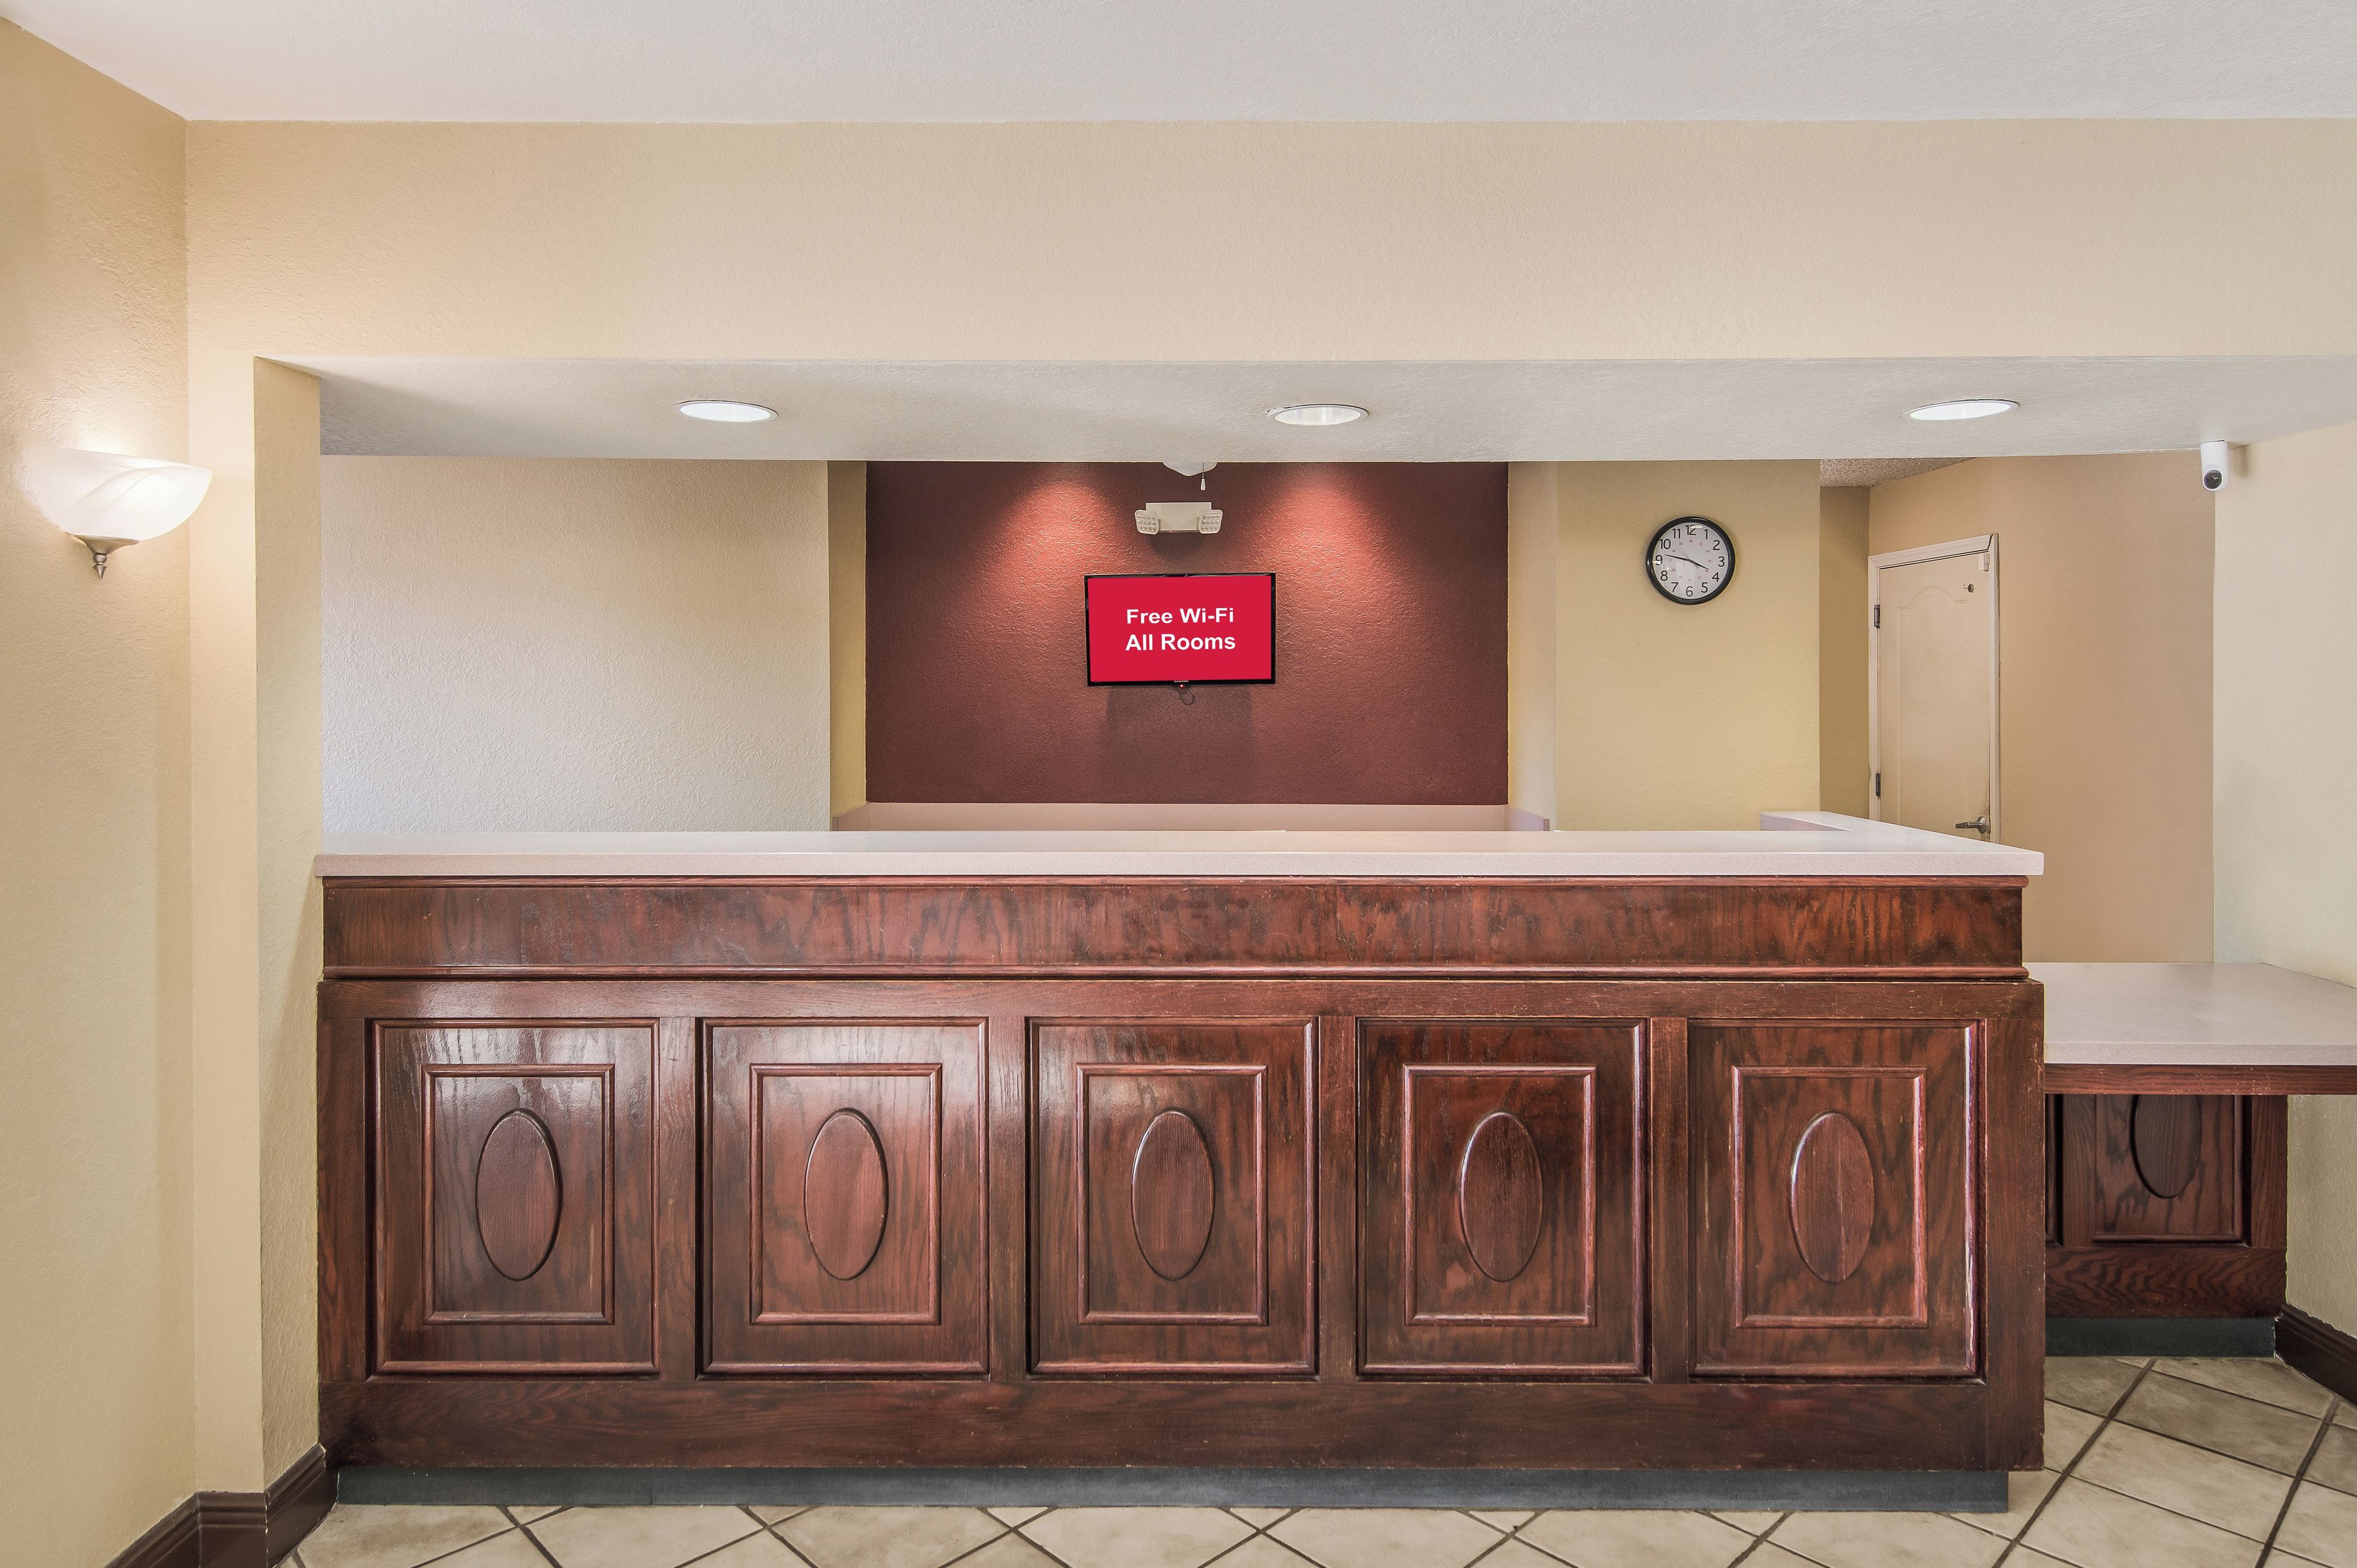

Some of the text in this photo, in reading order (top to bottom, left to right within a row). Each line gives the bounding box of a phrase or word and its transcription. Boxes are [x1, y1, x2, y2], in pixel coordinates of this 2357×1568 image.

[1672, 528, 1681, 539] 11
[1685, 525, 1697, 535] 12
[1704, 529, 1708, 539] 1
[1659, 538, 1671, 550] 10
[1713, 539, 1720, 550] 2
[1655, 555, 1663, 565] 9
[1717, 556, 1725, 567] 3
[1660, 570, 1668, 581] 8
[1711, 572, 1720, 582] 4
[1671, 582, 1679, 592] 7
[1686, 586, 1693, 597] 6
[1701, 582, 1708, 593] 5
[1127, 608, 1233, 624] Free Wi-Fi
[1126, 634, 1235, 651] All Rooms
